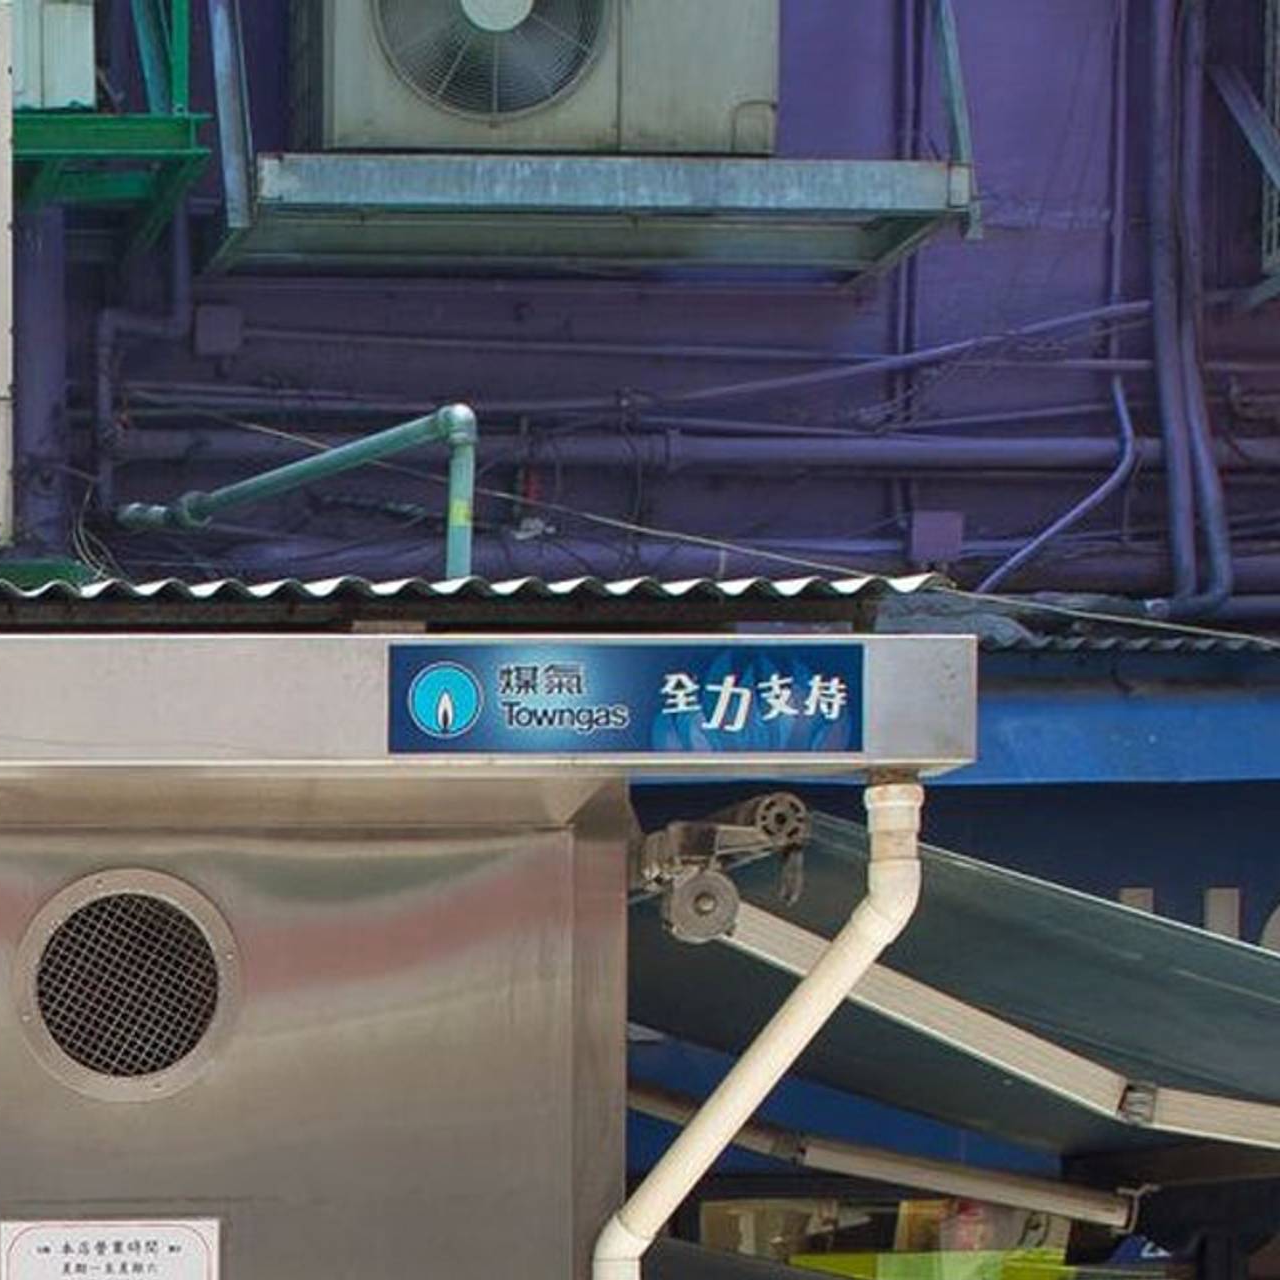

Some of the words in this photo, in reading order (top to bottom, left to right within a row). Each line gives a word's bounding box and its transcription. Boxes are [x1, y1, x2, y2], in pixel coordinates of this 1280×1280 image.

[497, 661, 584, 697] 煤氣
[501, 701, 630, 732] Towngas
[660, 672, 848, 732] 全力支持
